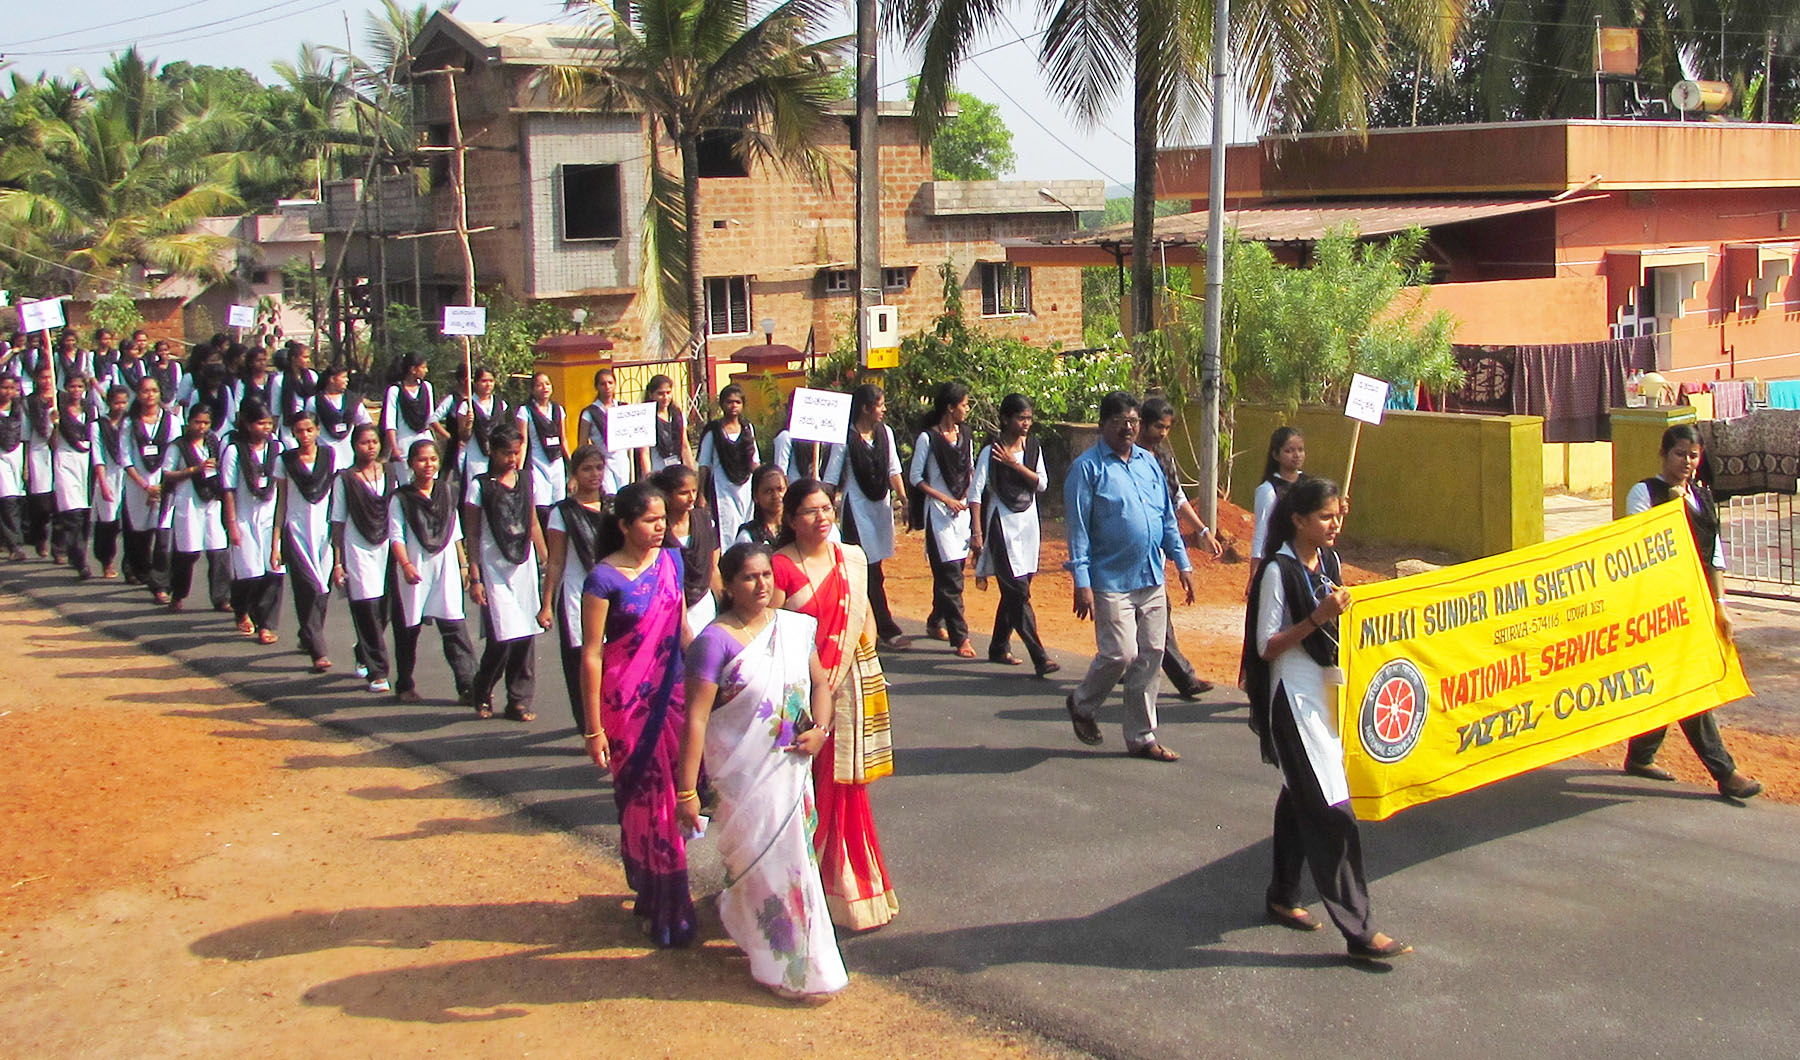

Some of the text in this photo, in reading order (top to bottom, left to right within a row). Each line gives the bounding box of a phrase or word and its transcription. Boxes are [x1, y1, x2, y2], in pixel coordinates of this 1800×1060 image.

[1359, 528, 1678, 650] MULKI SUNDER RAM SHETTY COLLEGE
[1440, 652, 1532, 713] NATIONAL
[1539, 622, 1620, 677] SERVICE
[1625, 596, 1690, 648] SCHEME
